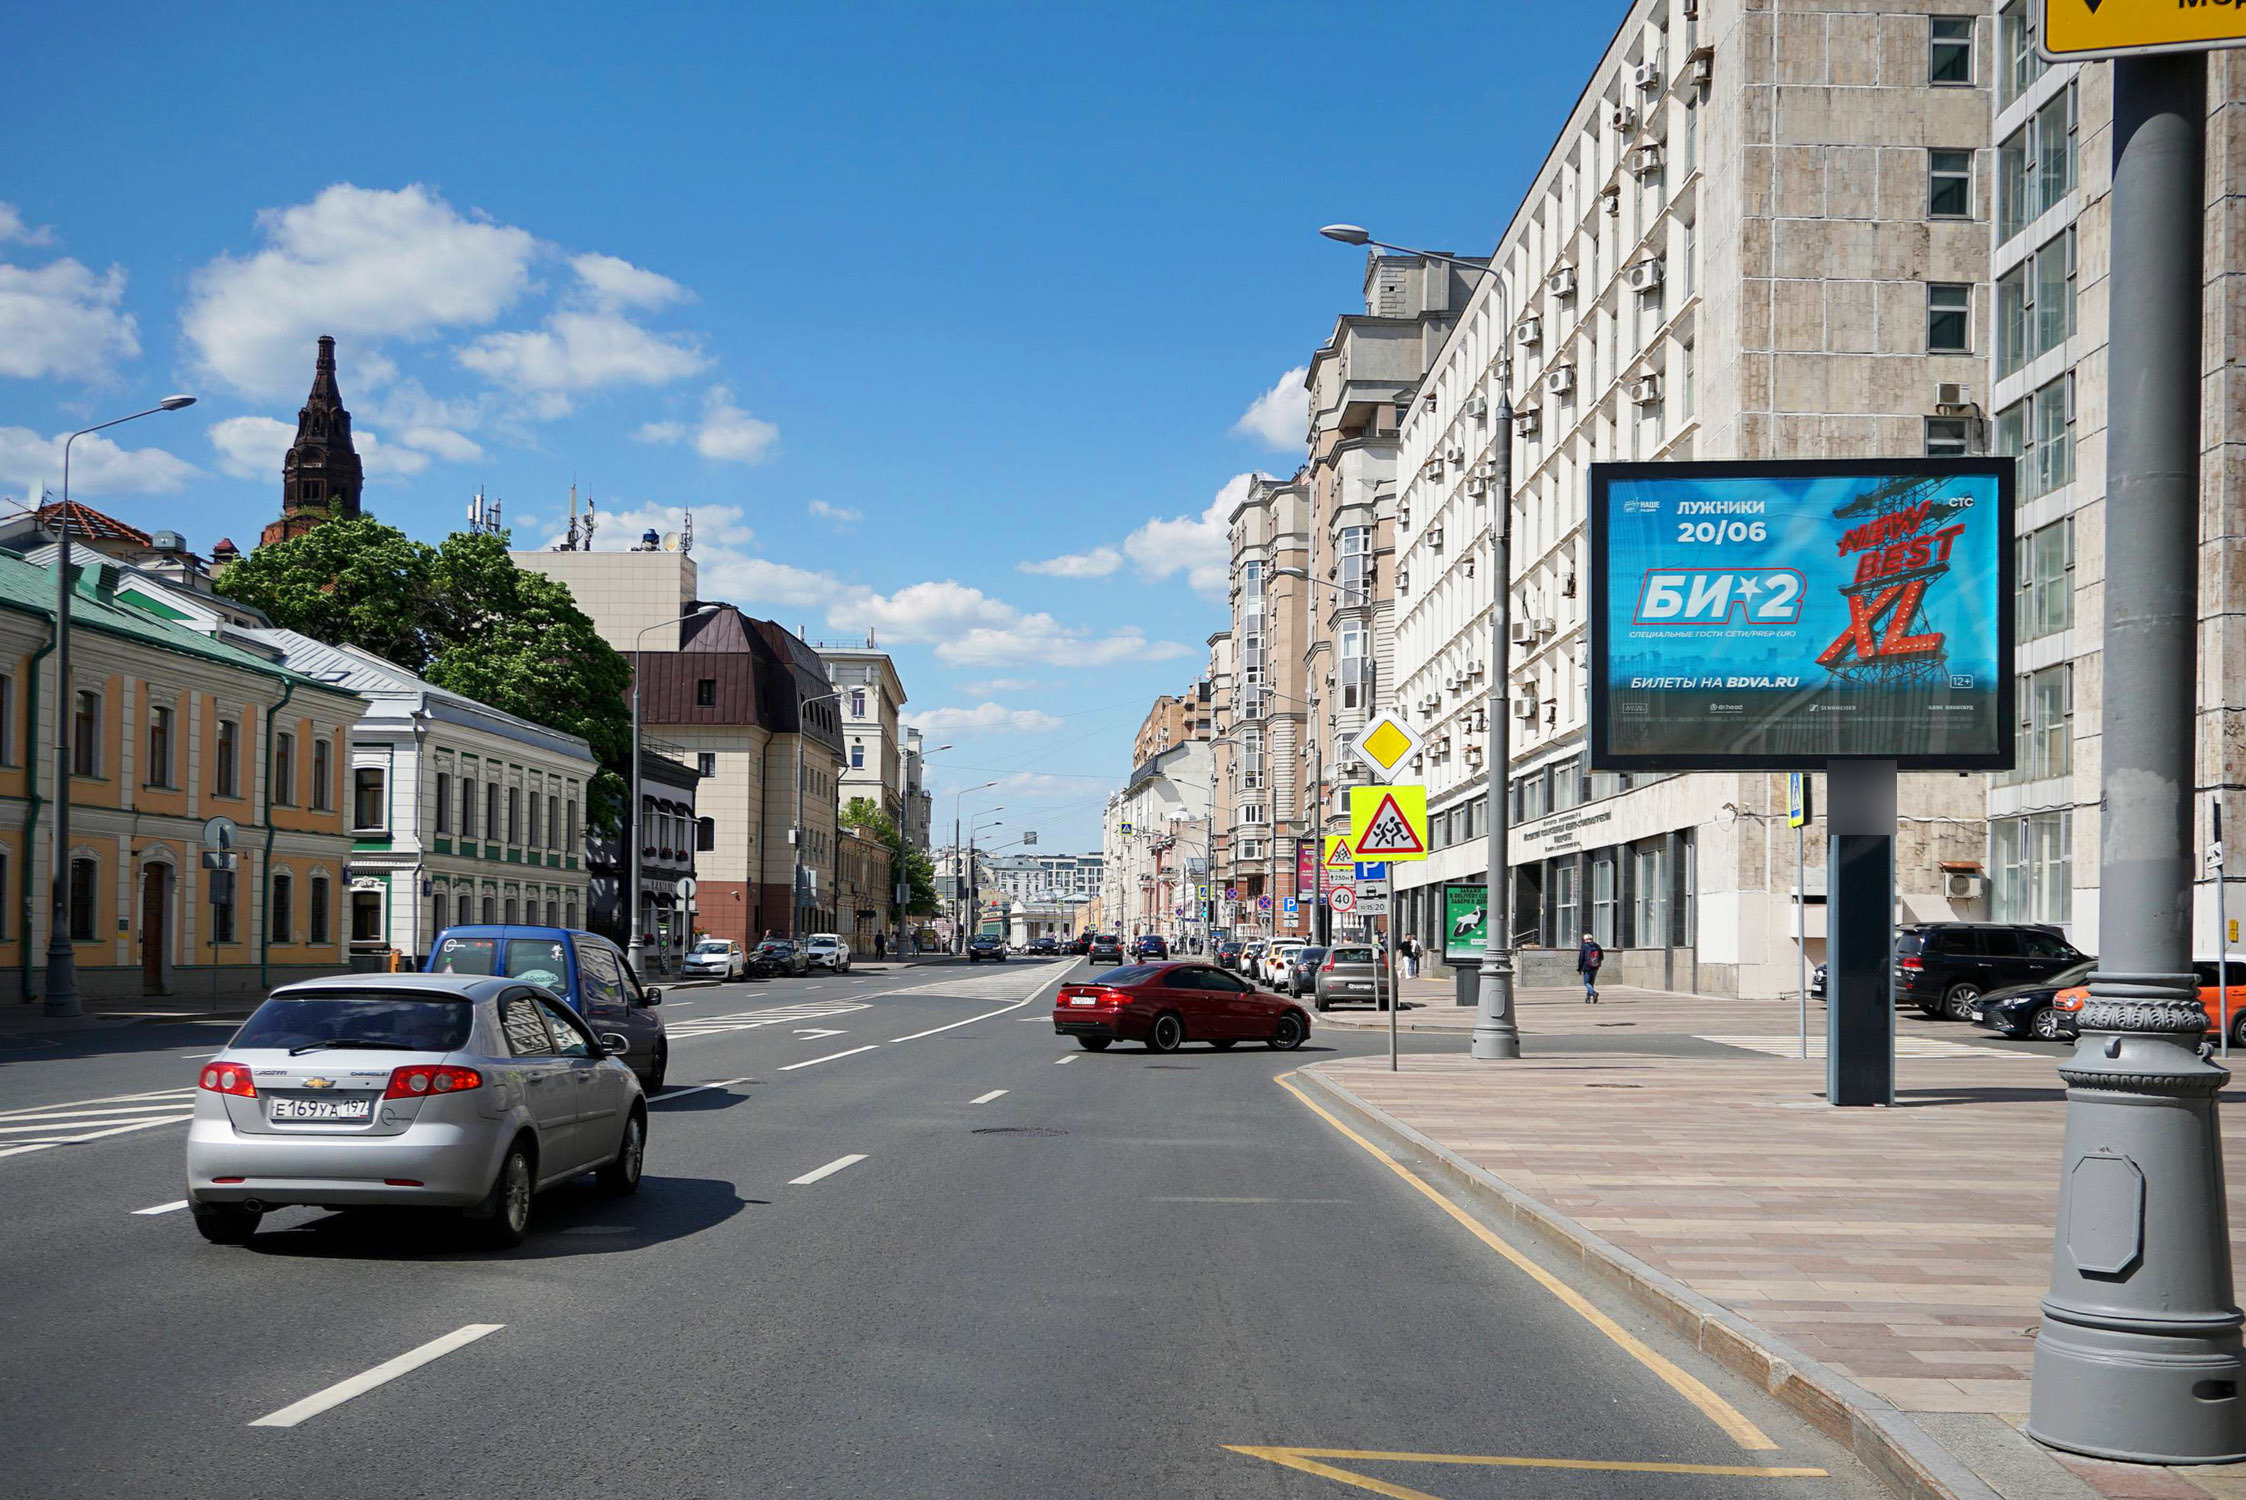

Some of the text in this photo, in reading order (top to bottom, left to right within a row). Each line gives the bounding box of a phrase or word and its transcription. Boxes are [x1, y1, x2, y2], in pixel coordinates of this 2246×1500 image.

[1677, 501, 1766, 515] ЛУЖНИКИ
[1949, 498, 1974, 507] СТС
[1677, 520, 1767, 545] 20/06
[1839, 500, 1932, 557] NEW
[1854, 523, 1966, 584] BEST
[1815, 580, 1944, 663] XL
[1629, 631, 1694, 639] СПЕЦИАЛЬНЫЕ
[1695, 630, 1723, 638] ГОСТИ
[1631, 676, 1800, 688] БИЛЕТЫ НА BDVA.RU
[1952, 677, 1972, 687] 12+
[1287, 899, 1296, 911] P
[1335, 894, 1350, 904] 40
